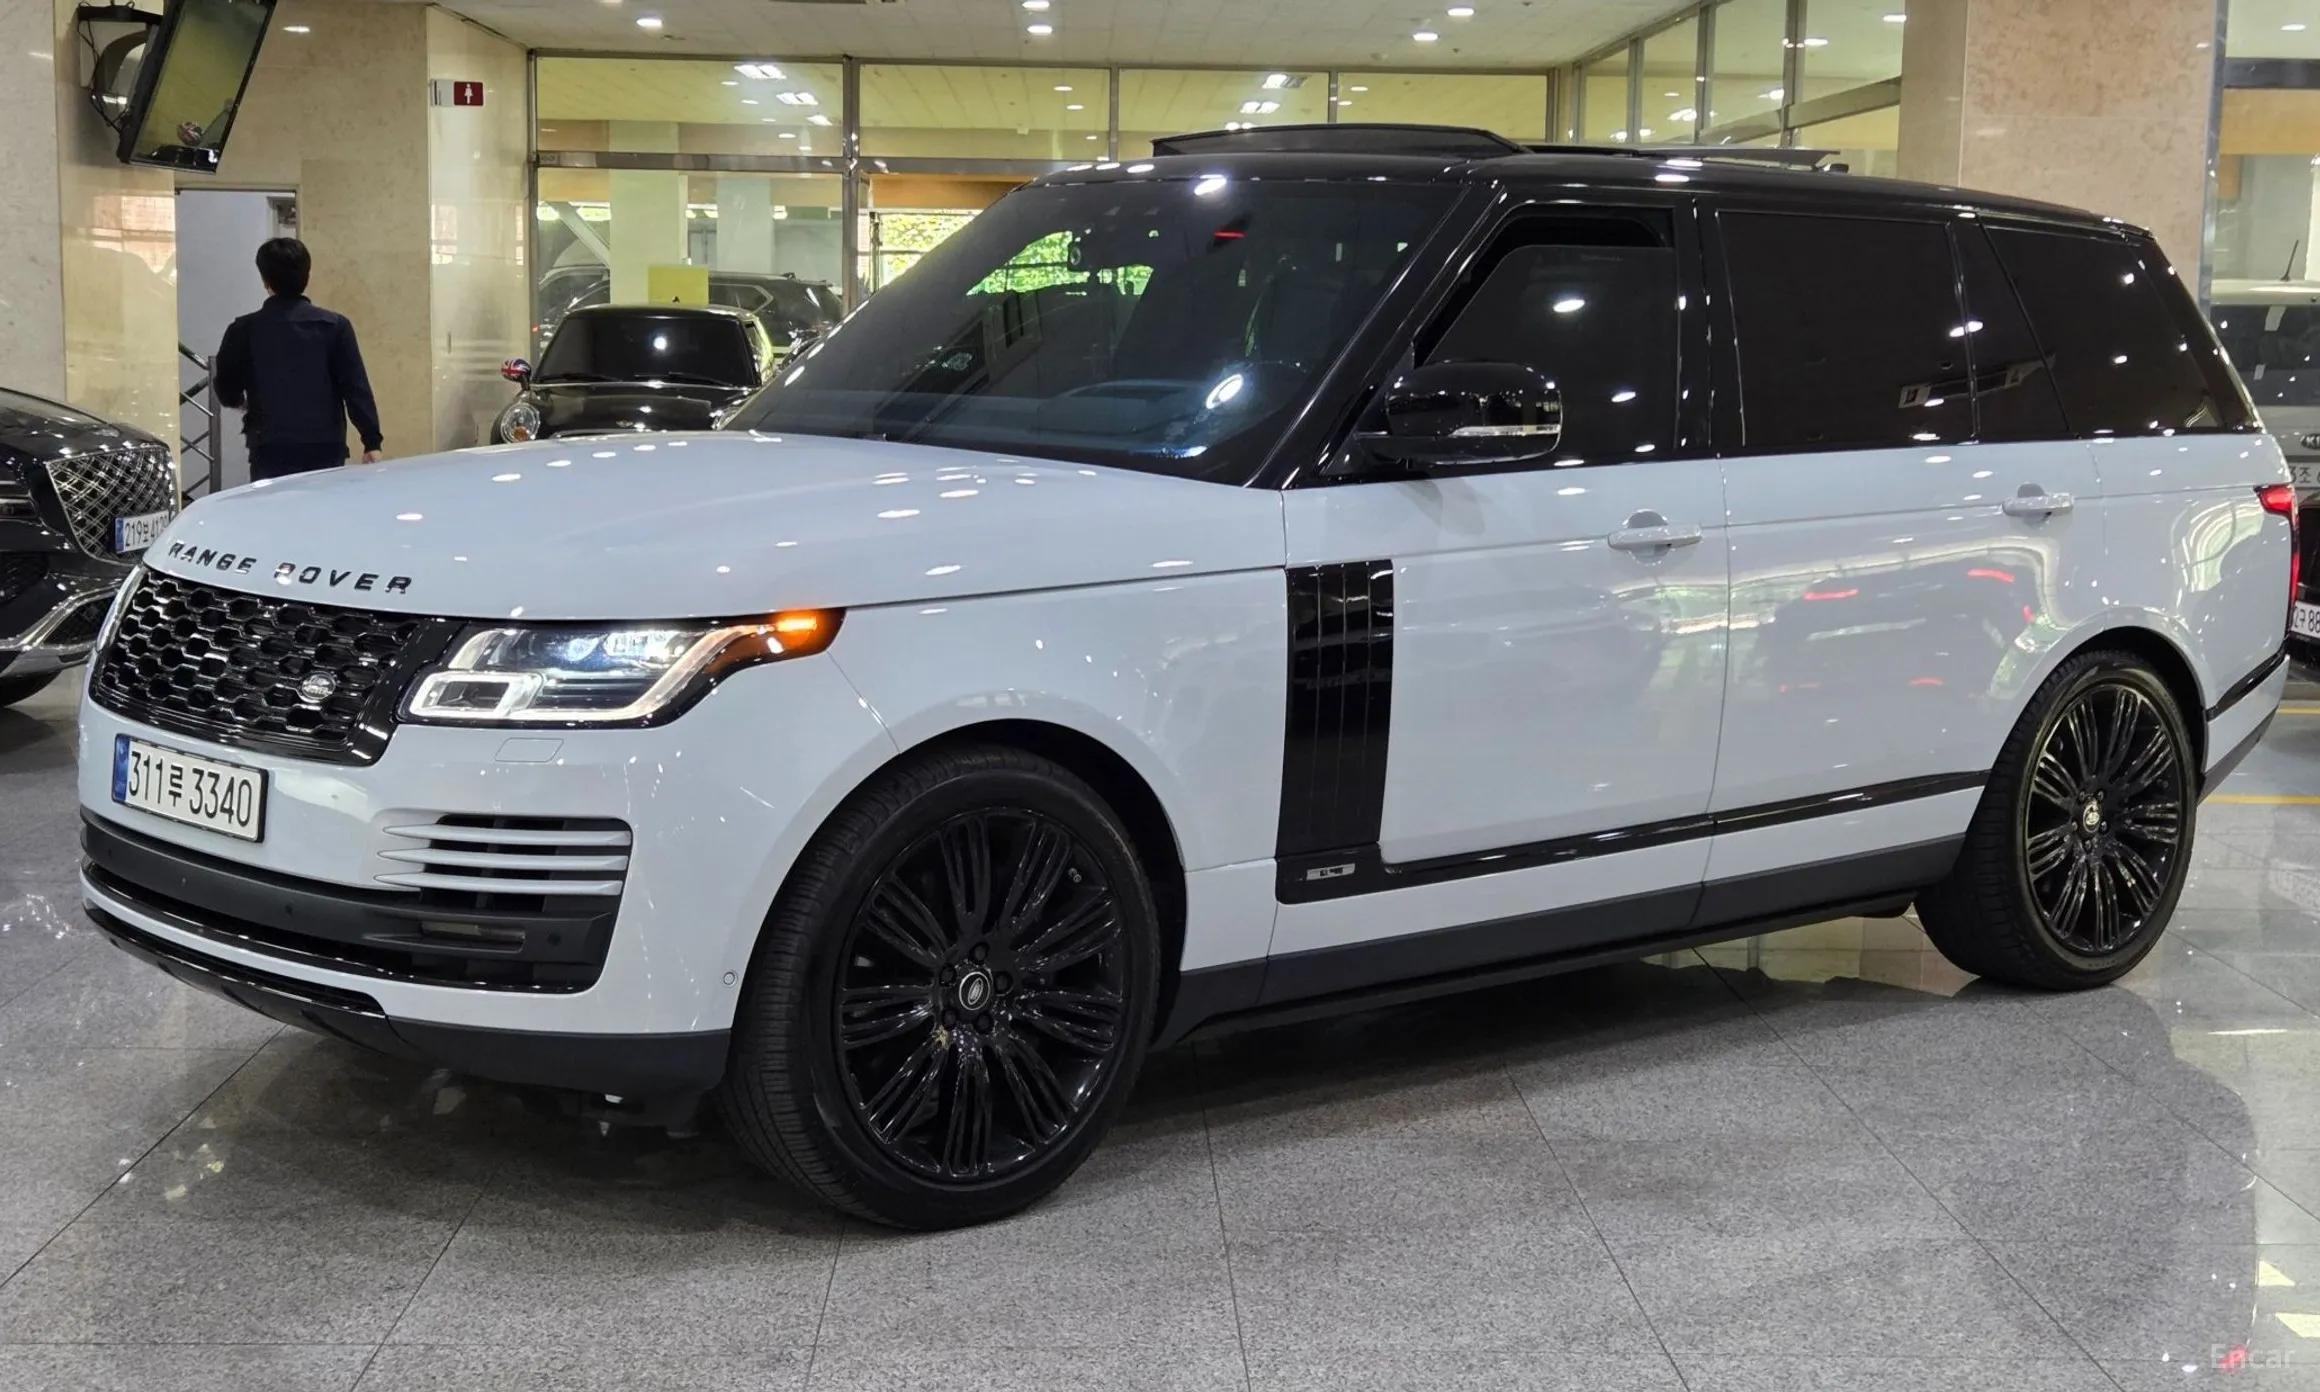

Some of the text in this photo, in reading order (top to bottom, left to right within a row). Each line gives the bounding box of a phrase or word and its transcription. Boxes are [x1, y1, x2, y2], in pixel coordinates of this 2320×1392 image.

[168, 541, 412, 595] RANGE ROVER
[129, 751, 252, 828] 311루 3340
